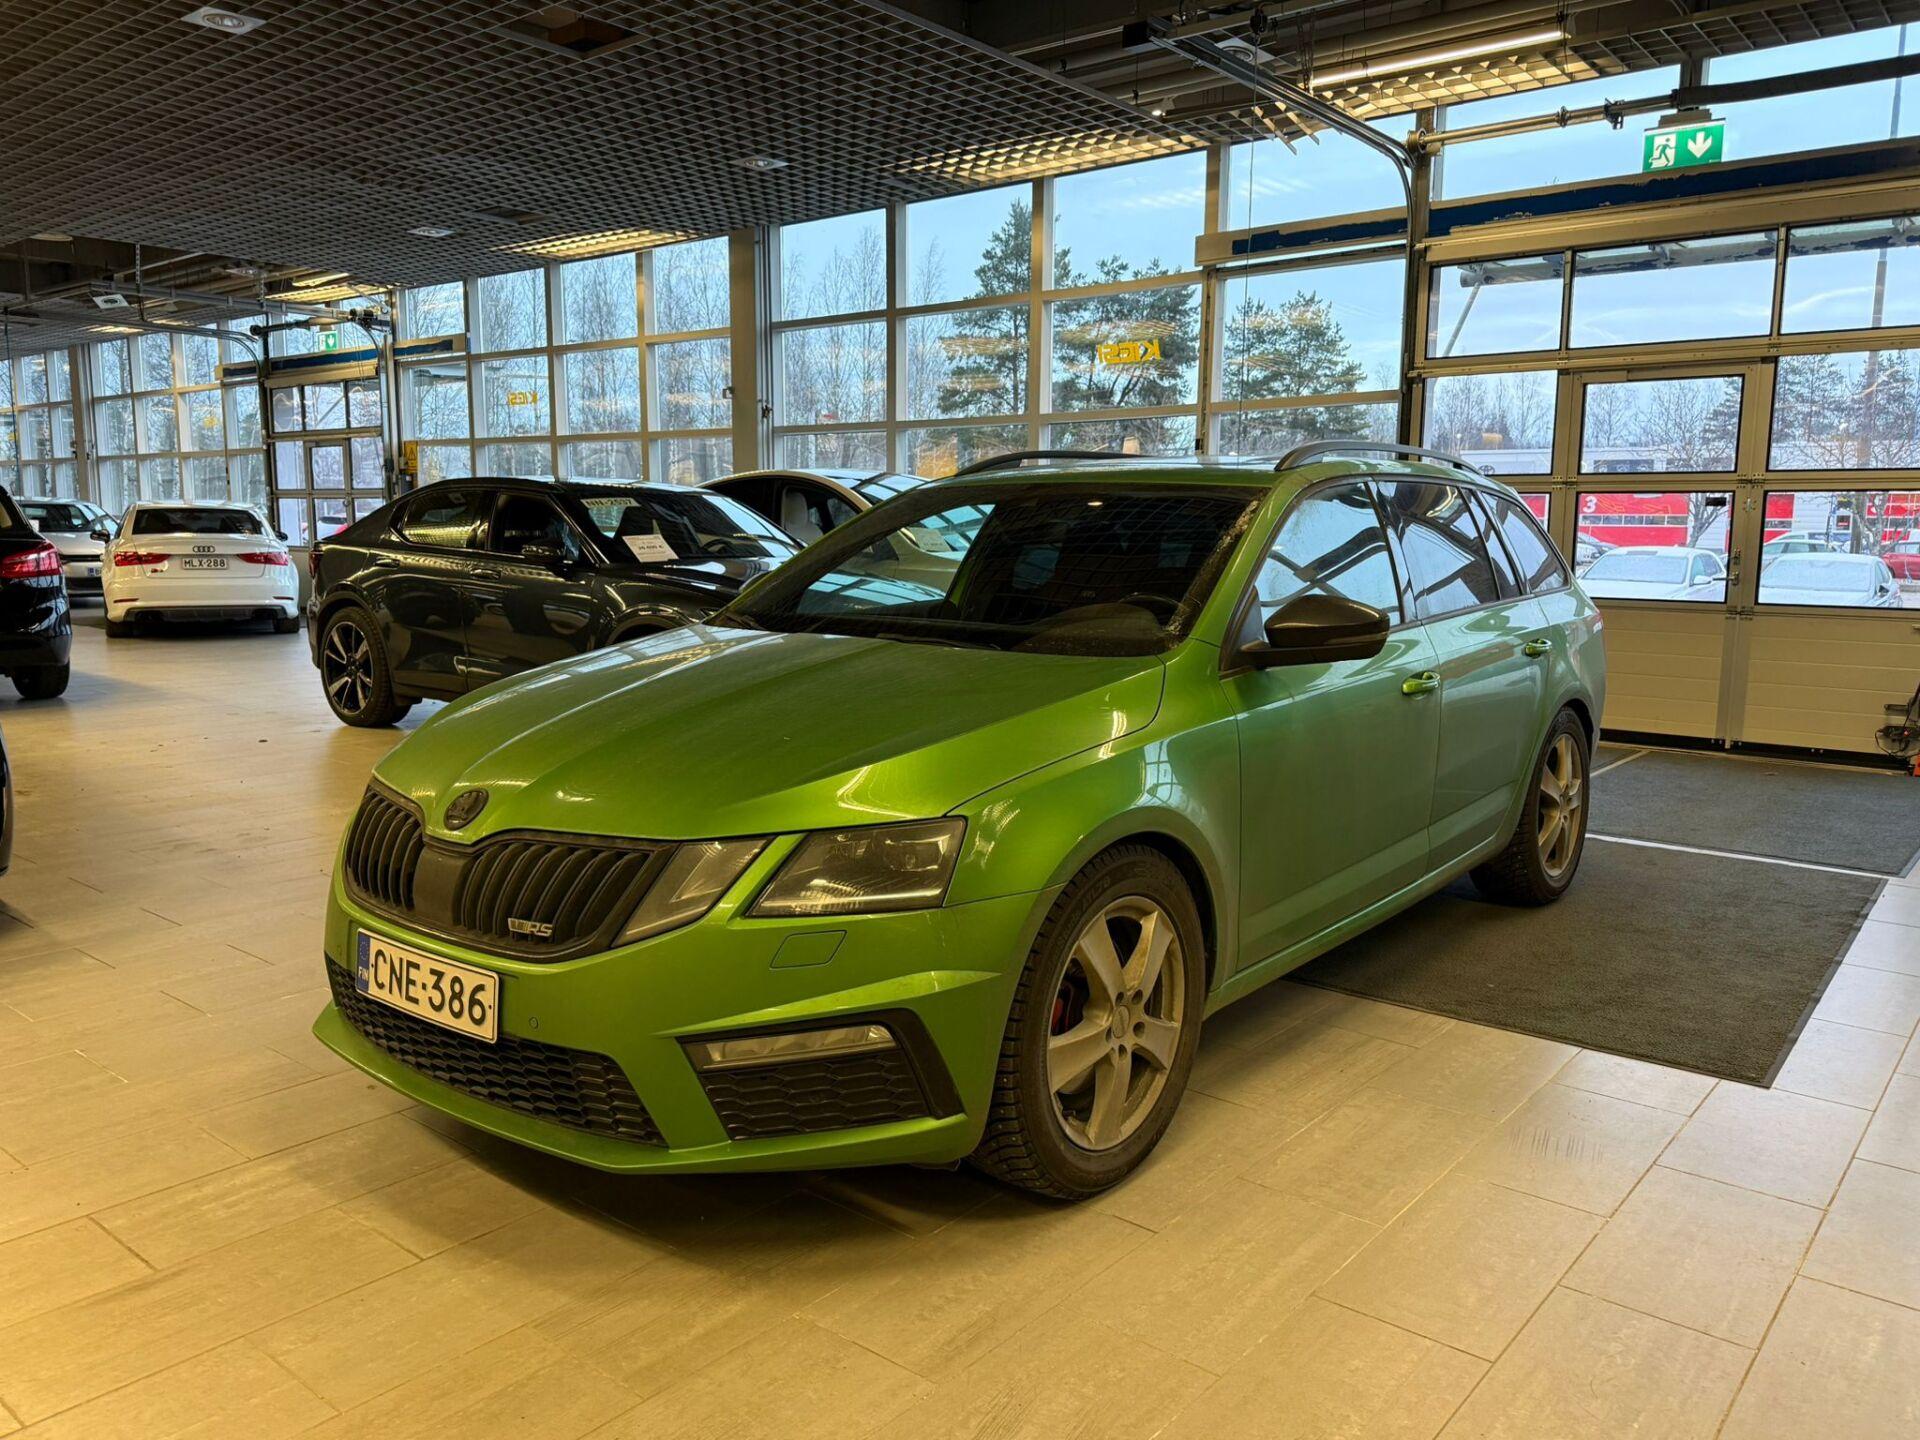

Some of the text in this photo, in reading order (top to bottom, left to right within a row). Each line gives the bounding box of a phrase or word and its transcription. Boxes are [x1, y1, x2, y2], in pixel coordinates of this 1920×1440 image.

[1583, 496, 1597, 513] 3
[184, 558, 226, 568] MLX-288
[358, 966, 369, 982] FIN
[373, 949, 487, 1026] CNE-386
